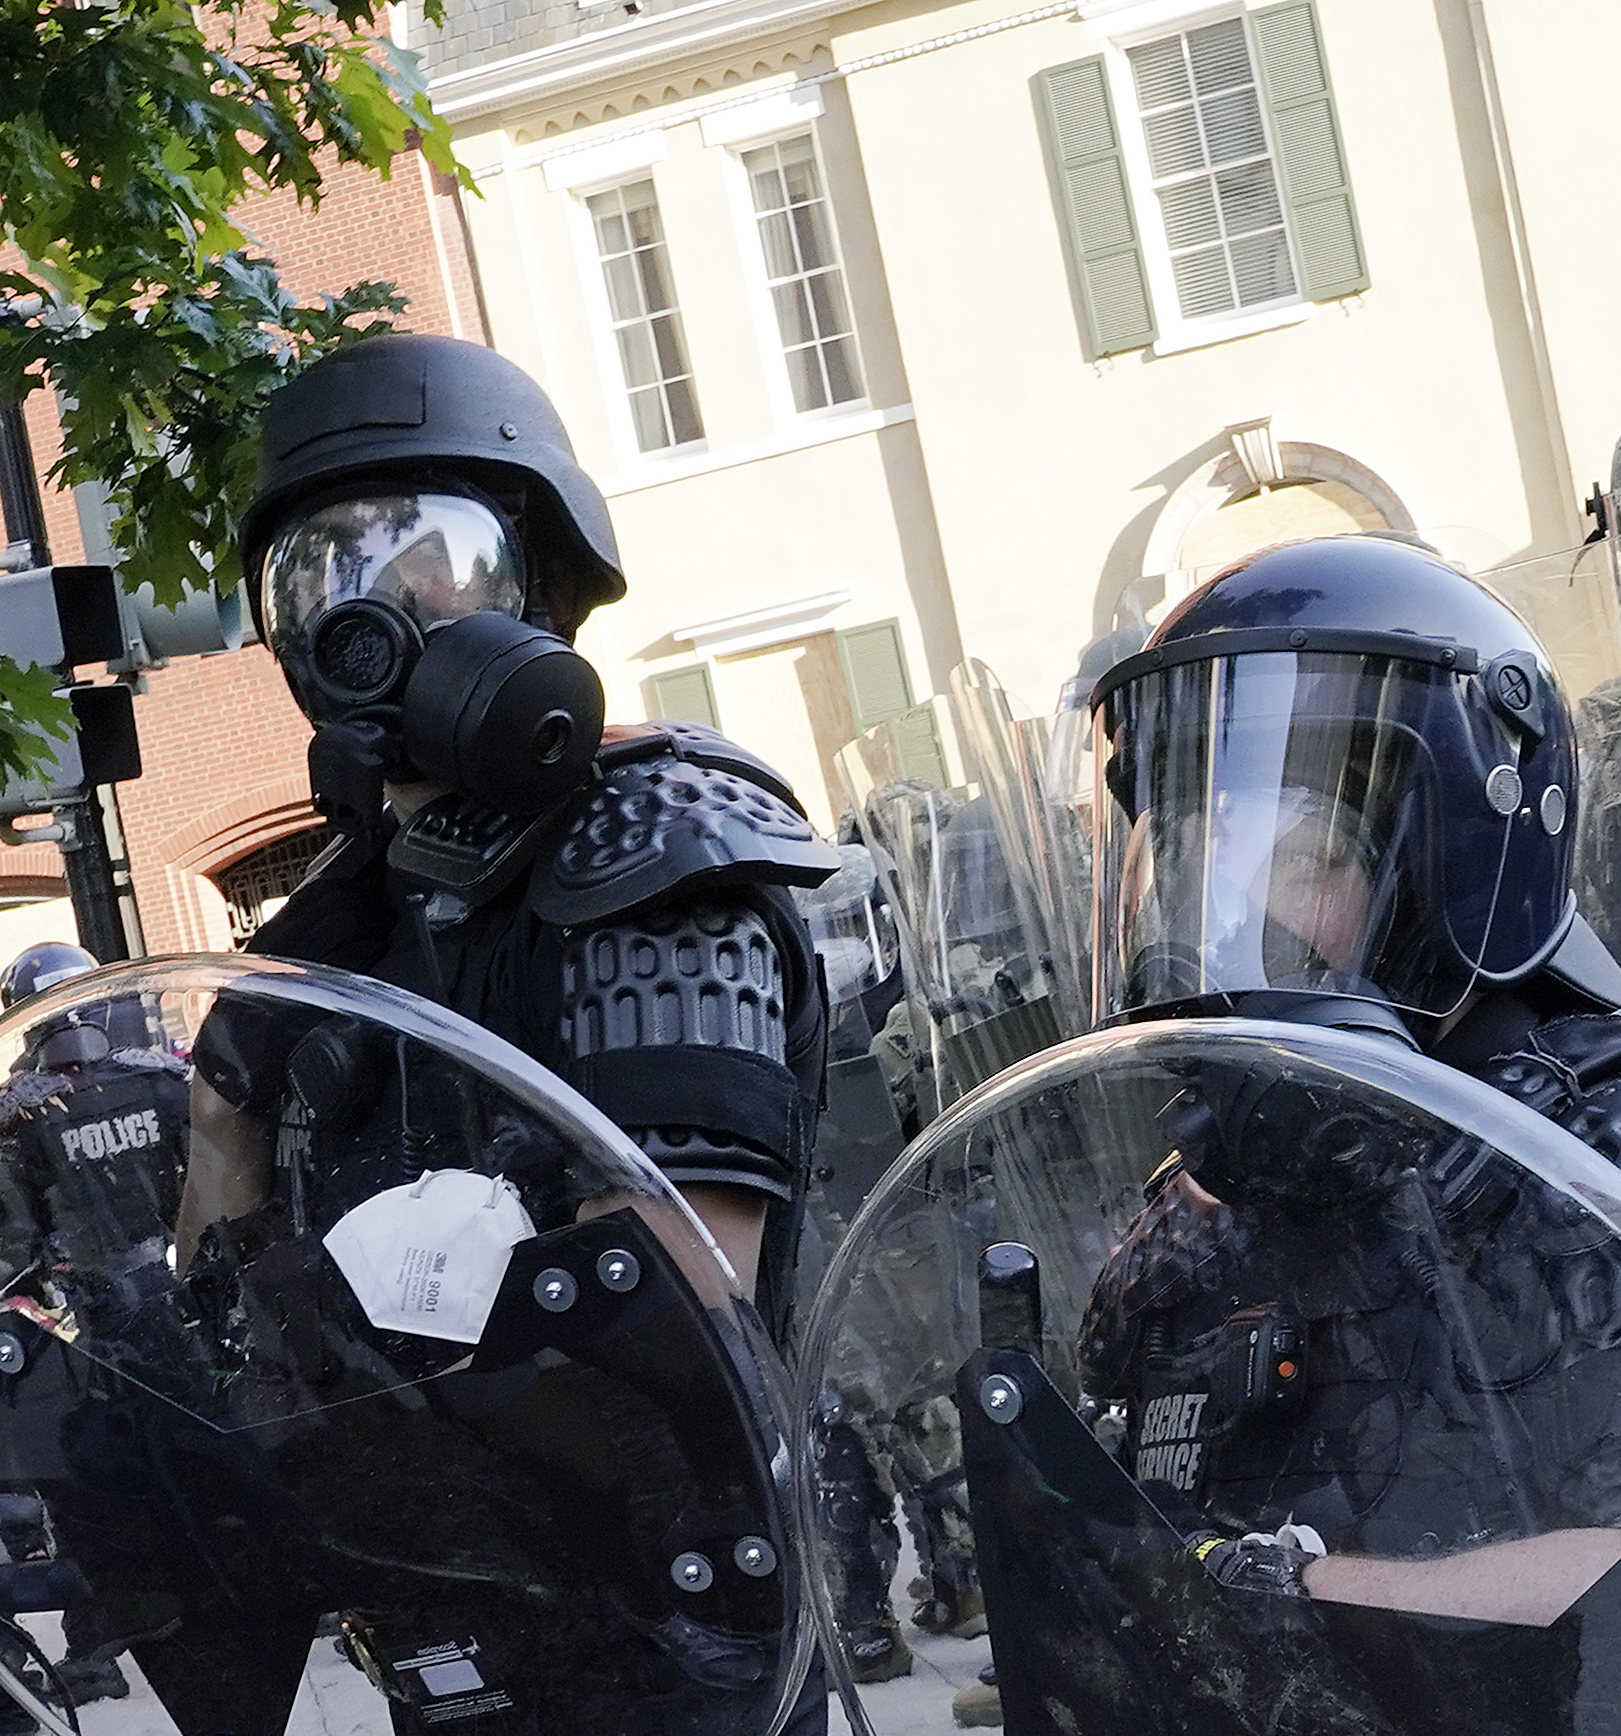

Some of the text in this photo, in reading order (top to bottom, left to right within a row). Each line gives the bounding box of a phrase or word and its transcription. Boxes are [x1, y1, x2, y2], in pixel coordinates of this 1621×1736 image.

[61, 1109, 161, 1162] POLICE
[425, 1281, 441, 1312] 9001
[1140, 1393, 1209, 1446] SECRET
